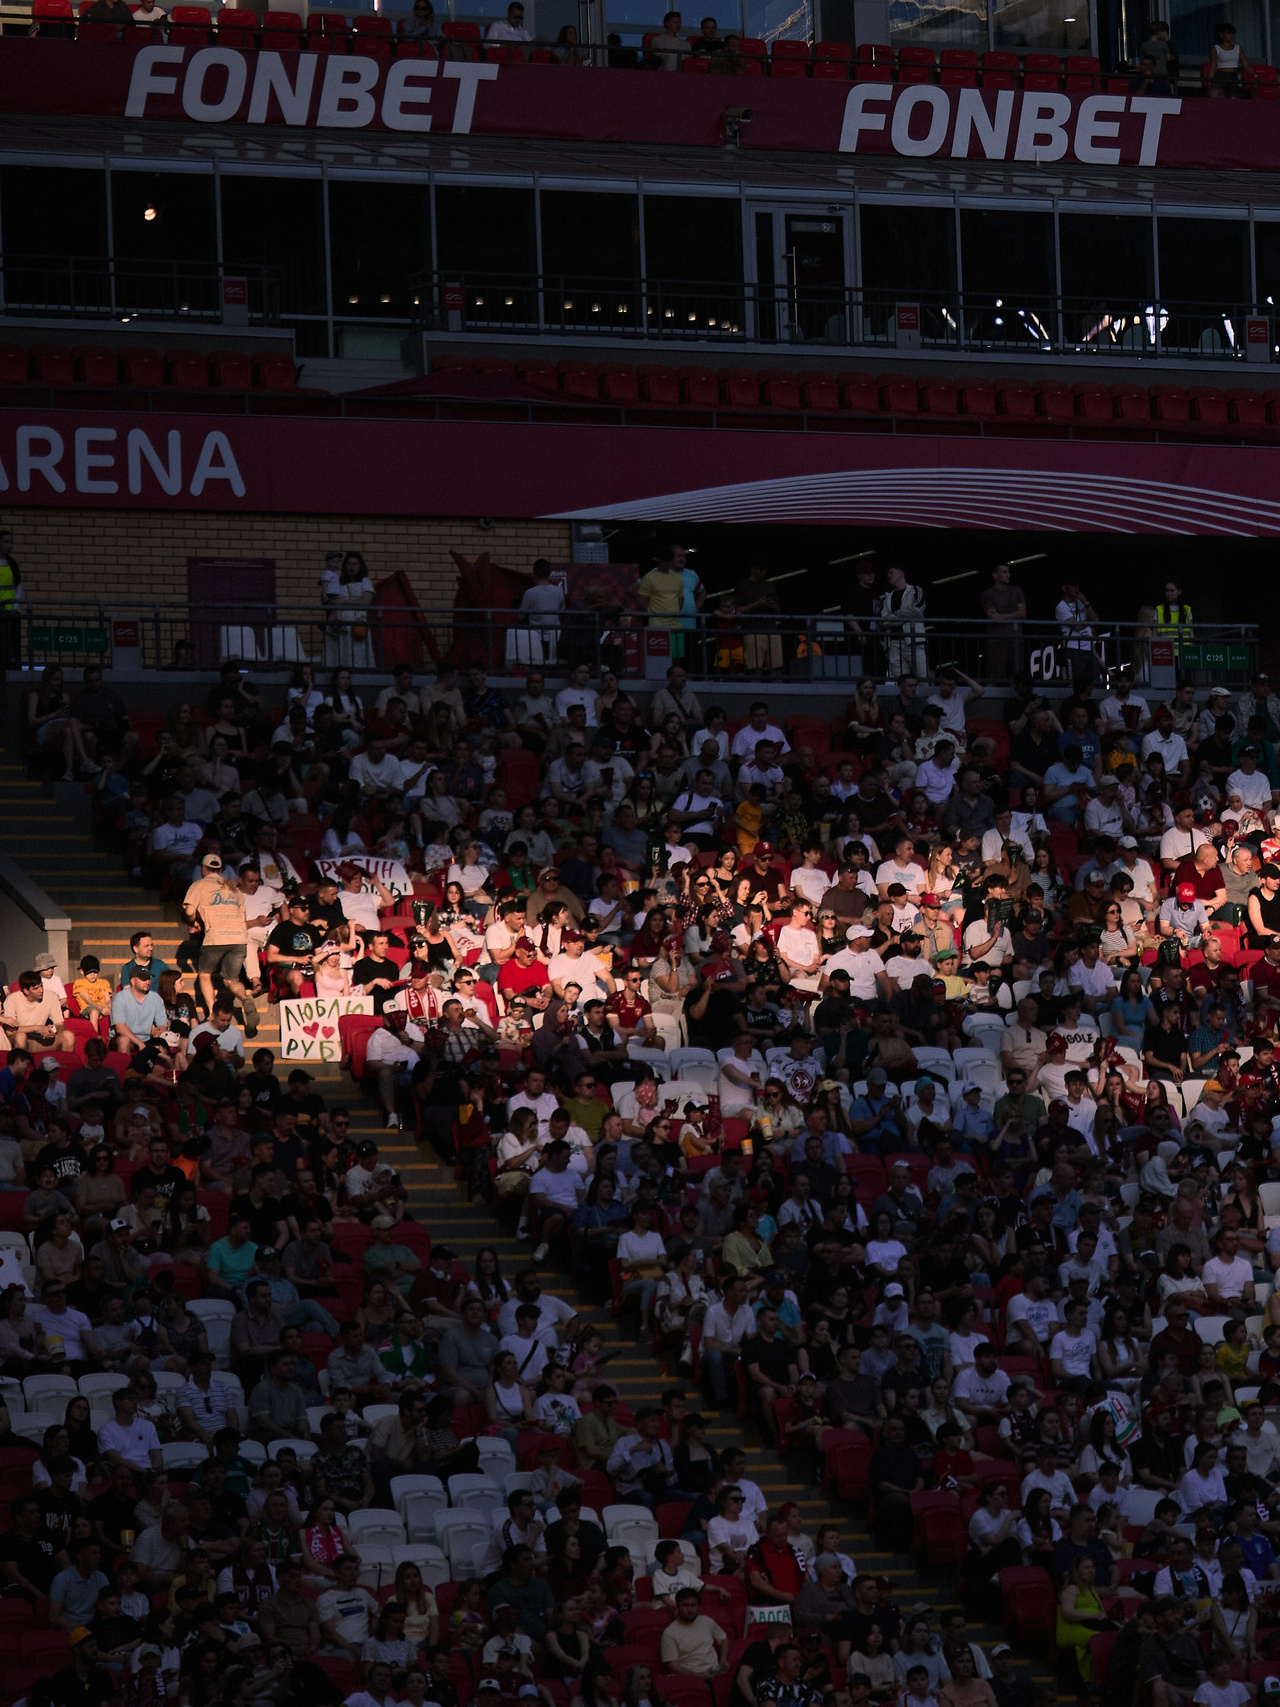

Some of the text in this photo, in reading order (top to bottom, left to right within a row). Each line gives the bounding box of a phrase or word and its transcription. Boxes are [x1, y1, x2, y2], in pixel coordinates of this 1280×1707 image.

[124, 44, 500, 134] FONBET
[838, 83, 1183, 167] FONBET
[0, 425, 247, 498] RENA
[285, 999, 365, 1032] ЛЮБЛЮ
[1063, 1033, 1093, 1044] GOLE
[286, 1038, 343, 1061] РУБ
